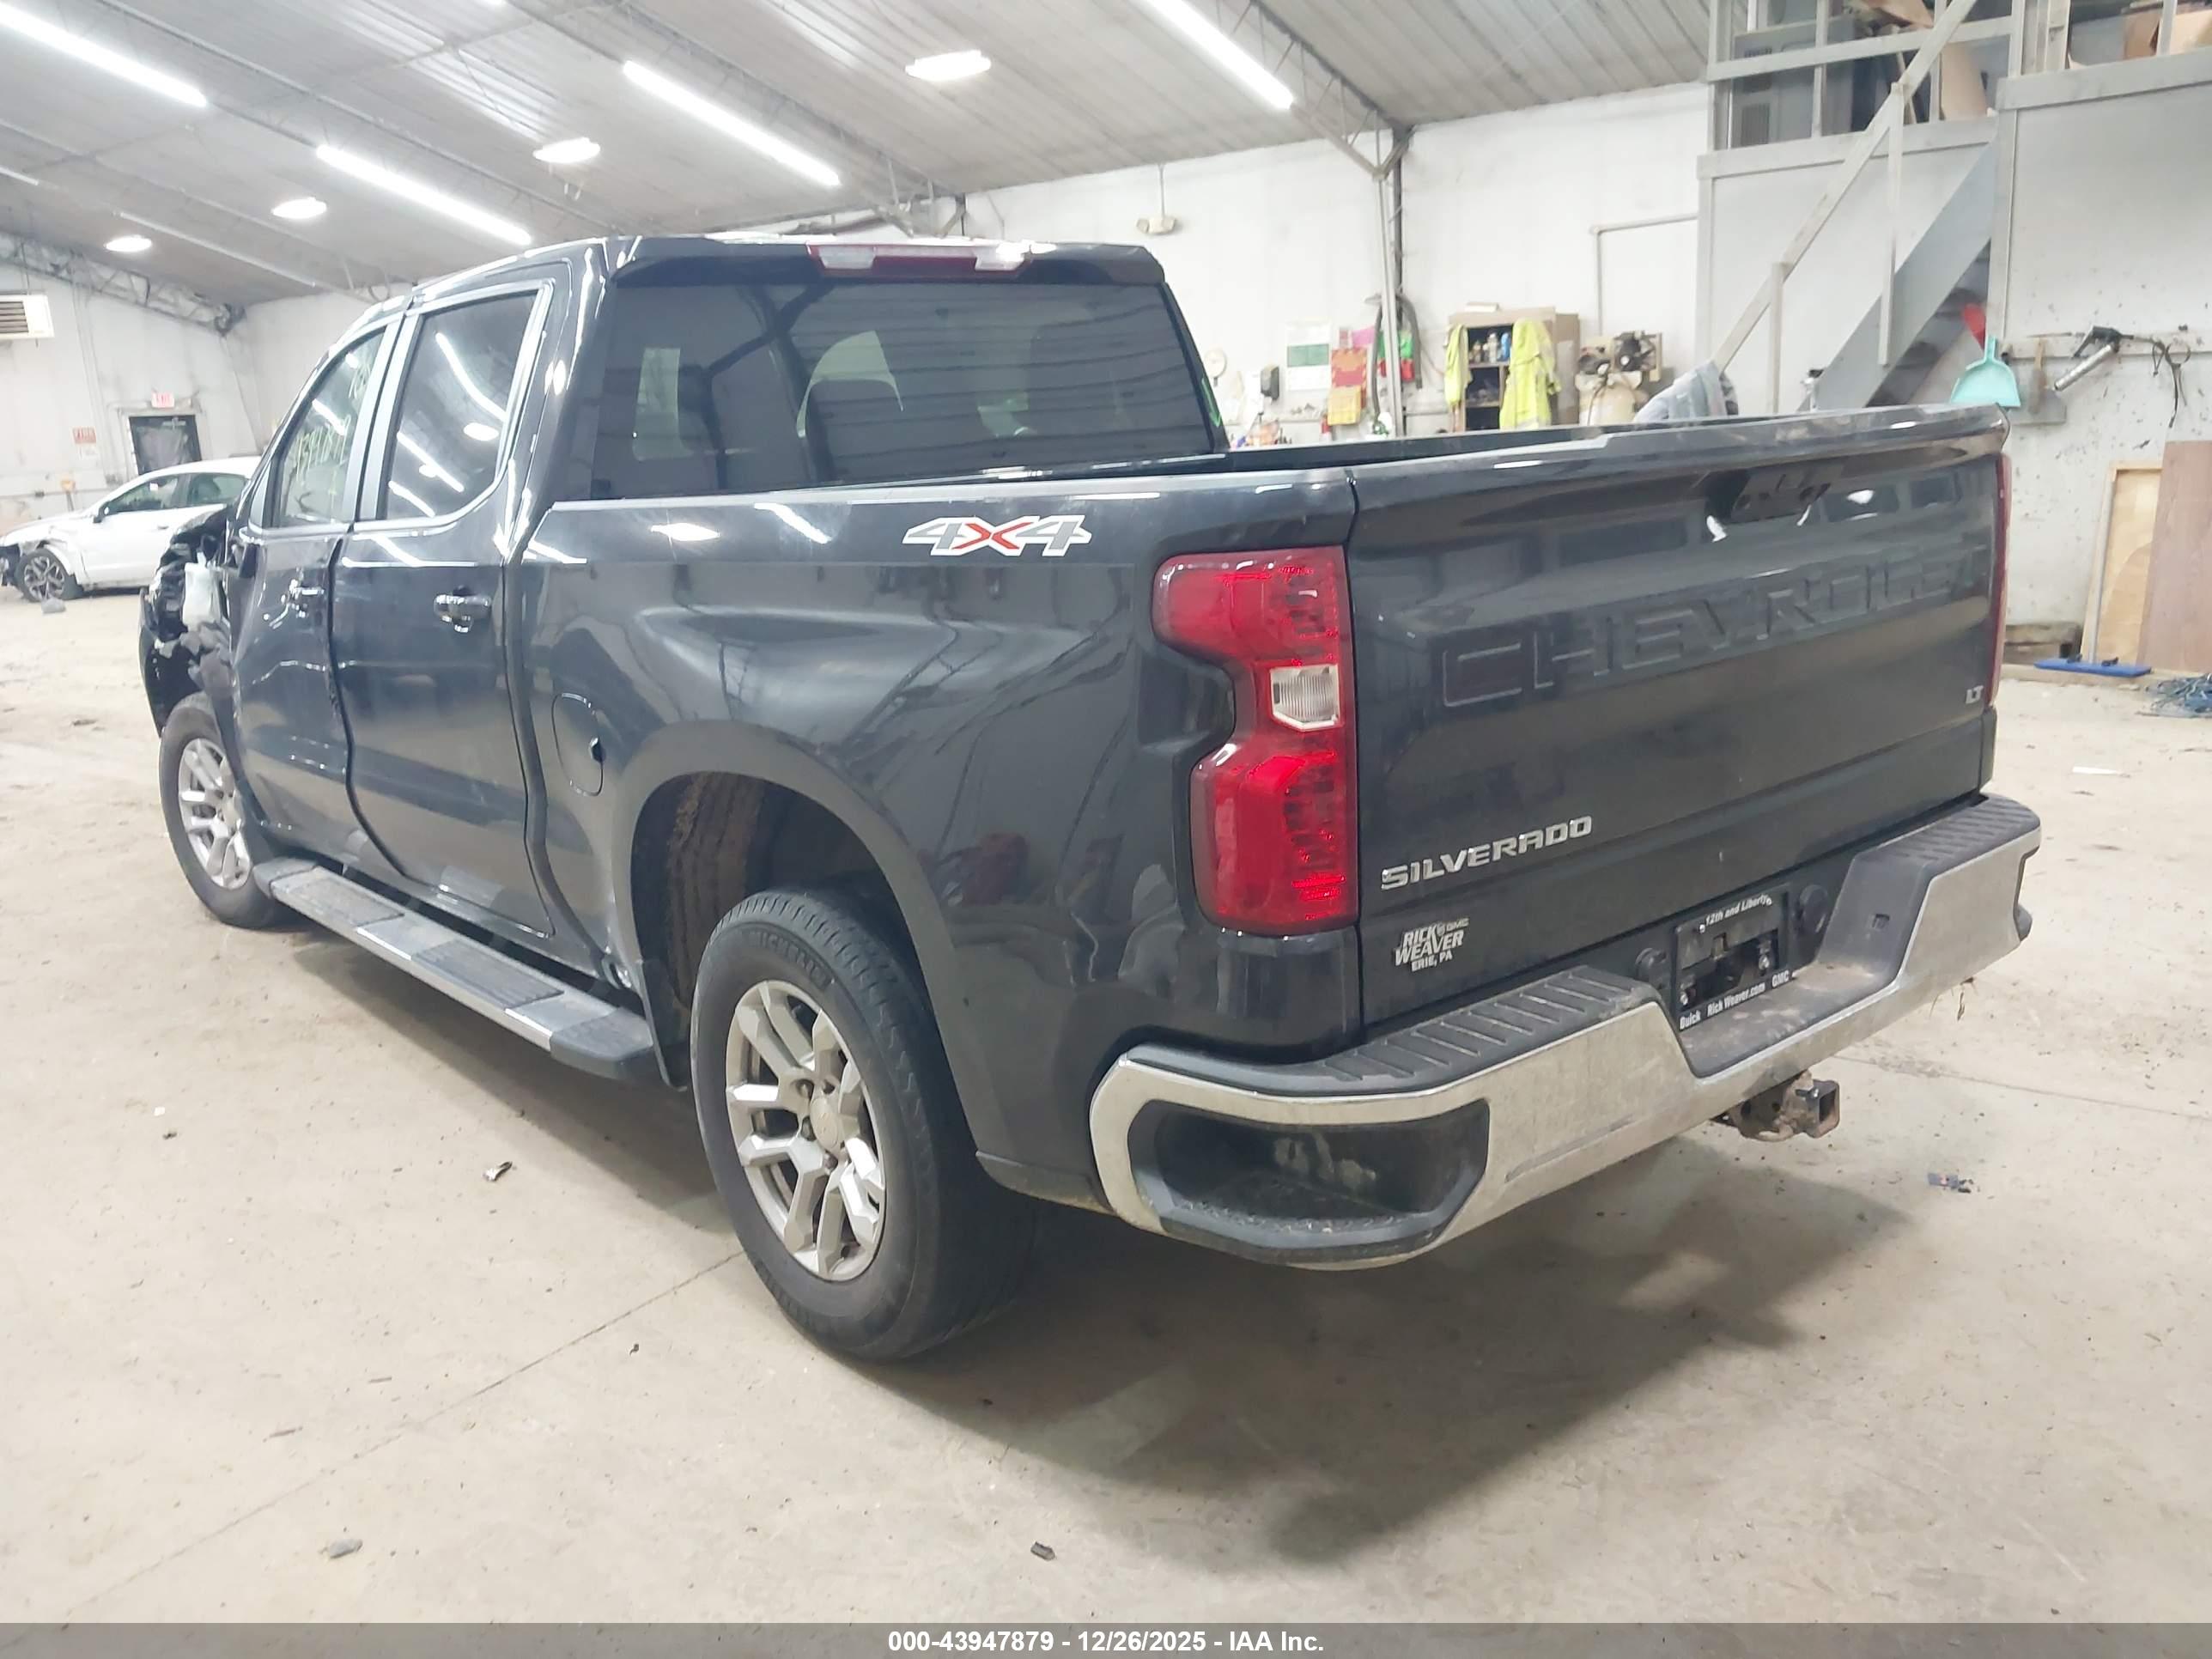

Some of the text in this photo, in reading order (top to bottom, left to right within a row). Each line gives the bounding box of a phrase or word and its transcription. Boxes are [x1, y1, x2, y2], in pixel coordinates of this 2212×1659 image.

[1443, 544, 1987, 707] CHEVROLET
[1966, 685, 1984, 704] LT
[1381, 816, 1592, 890] SILVERADO
[1705, 893, 1769, 926] 12th and Liberty
[1395, 929, 1465, 966] WEAVER
[1402, 924, 1437, 949] RICK
[1439, 950, 1453, 963] PA
[1771, 969, 1790, 988] GMC
[1707, 982, 1765, 1017] Rick Weaver.com
